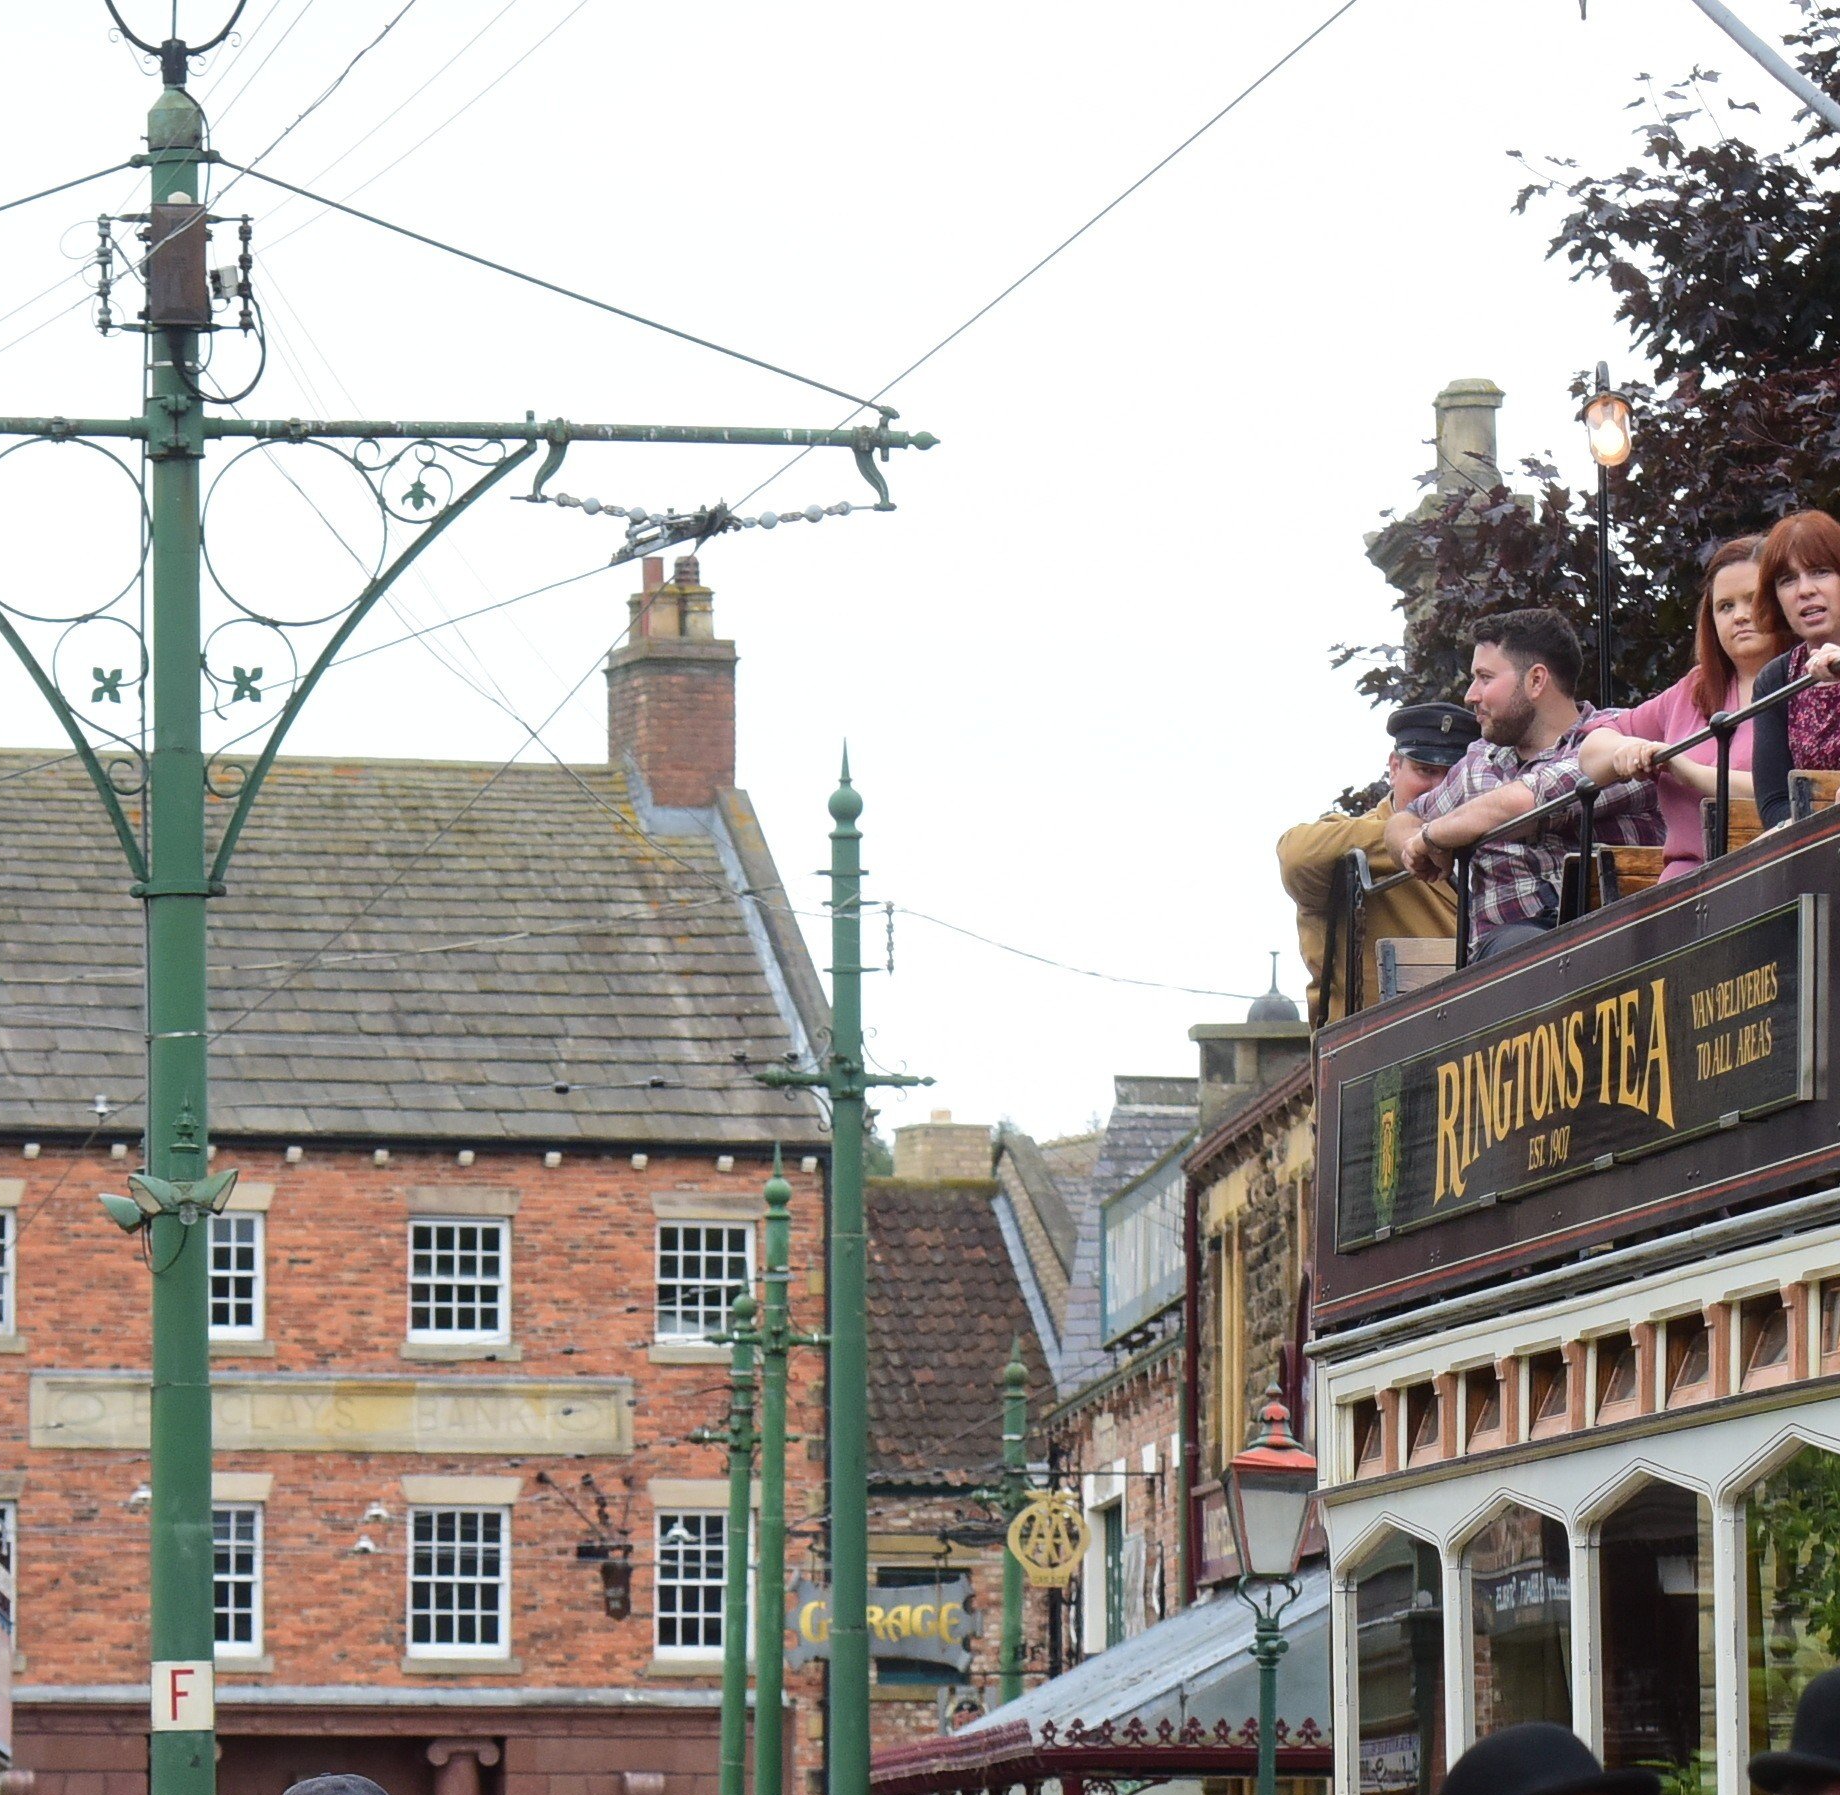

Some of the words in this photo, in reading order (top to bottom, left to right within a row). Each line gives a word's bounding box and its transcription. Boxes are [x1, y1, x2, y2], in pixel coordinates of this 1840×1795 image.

[1690, 987, 1714, 1030] VAN
[1716, 961, 1778, 1021] DELIVERIES
[1697, 1042, 1711, 1081] TO
[1711, 1033, 1732, 1077] ALL
[1736, 1017, 1772, 1068] AREAS
[1433, 1011, 1584, 1207] RINGTONS
[1593, 978, 1675, 1129] TEA
[1528, 1134, 1546, 1171] EST.
[1549, 1125, 1571, 1168] 1907
[799, 1601, 963, 1645] GRAGE
[170, 1669, 195, 1721] F
